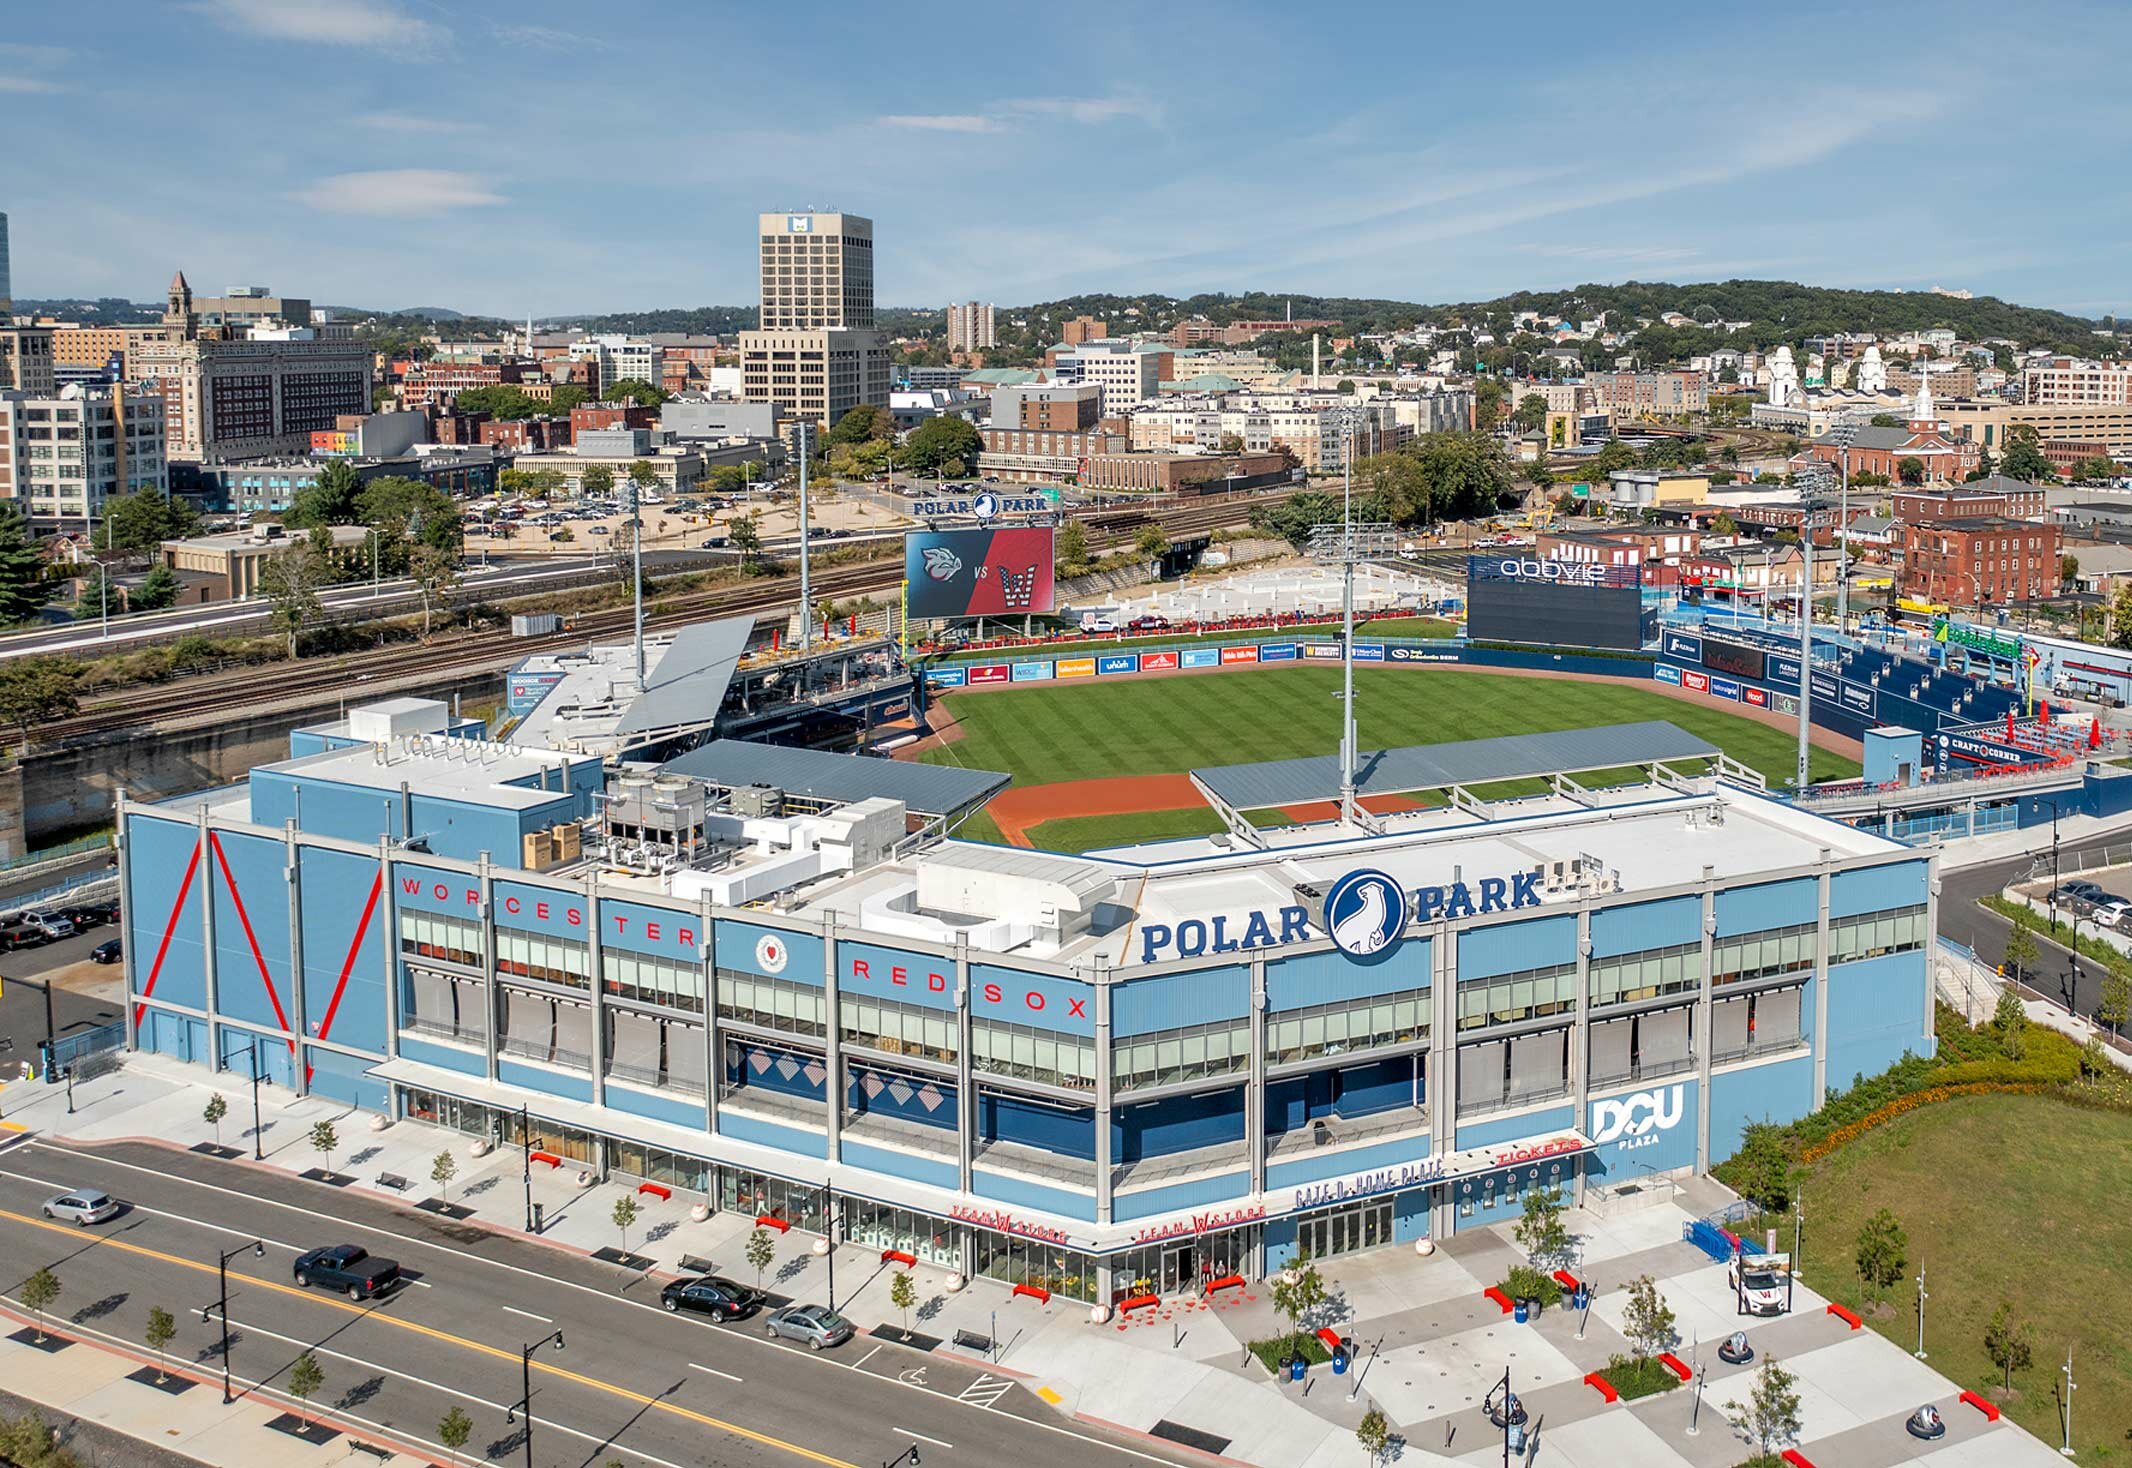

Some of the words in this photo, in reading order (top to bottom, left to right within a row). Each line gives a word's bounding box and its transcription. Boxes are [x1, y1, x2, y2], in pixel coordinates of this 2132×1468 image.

[913, 501, 969, 515] POLAR
[1003, 498, 1047, 511] PARK
[974, 566, 988, 579] VS
[1500, 557, 1606, 581] abbvie
[1747, 691, 1764, 702] Hood
[1952, 739, 1979, 753] CRAFT
[1988, 748, 2020, 762] CORNER
[402, 877, 695, 947] WORCESTER
[1141, 905, 1311, 963] POLAR
[1416, 870, 1541, 922] PARK
[853, 960, 946, 992] RED
[984, 984, 1086, 1018] SOX
[1592, 1084, 1684, 1142] DCU
[1496, 1139, 1582, 1165] TICKETS
[1618, 1133, 1660, 1151] PLAZA
[1295, 1183, 1330, 1207] GATE
[1356, 1170, 1394, 1194] HOME
[1402, 1158, 1444, 1185] PLATE
[951, 1204, 992, 1228] TEAM
[1015, 1220, 1068, 1244] STORE
[1137, 1221, 1185, 1242] TEAM
[1213, 1205, 1266, 1228] STORE
